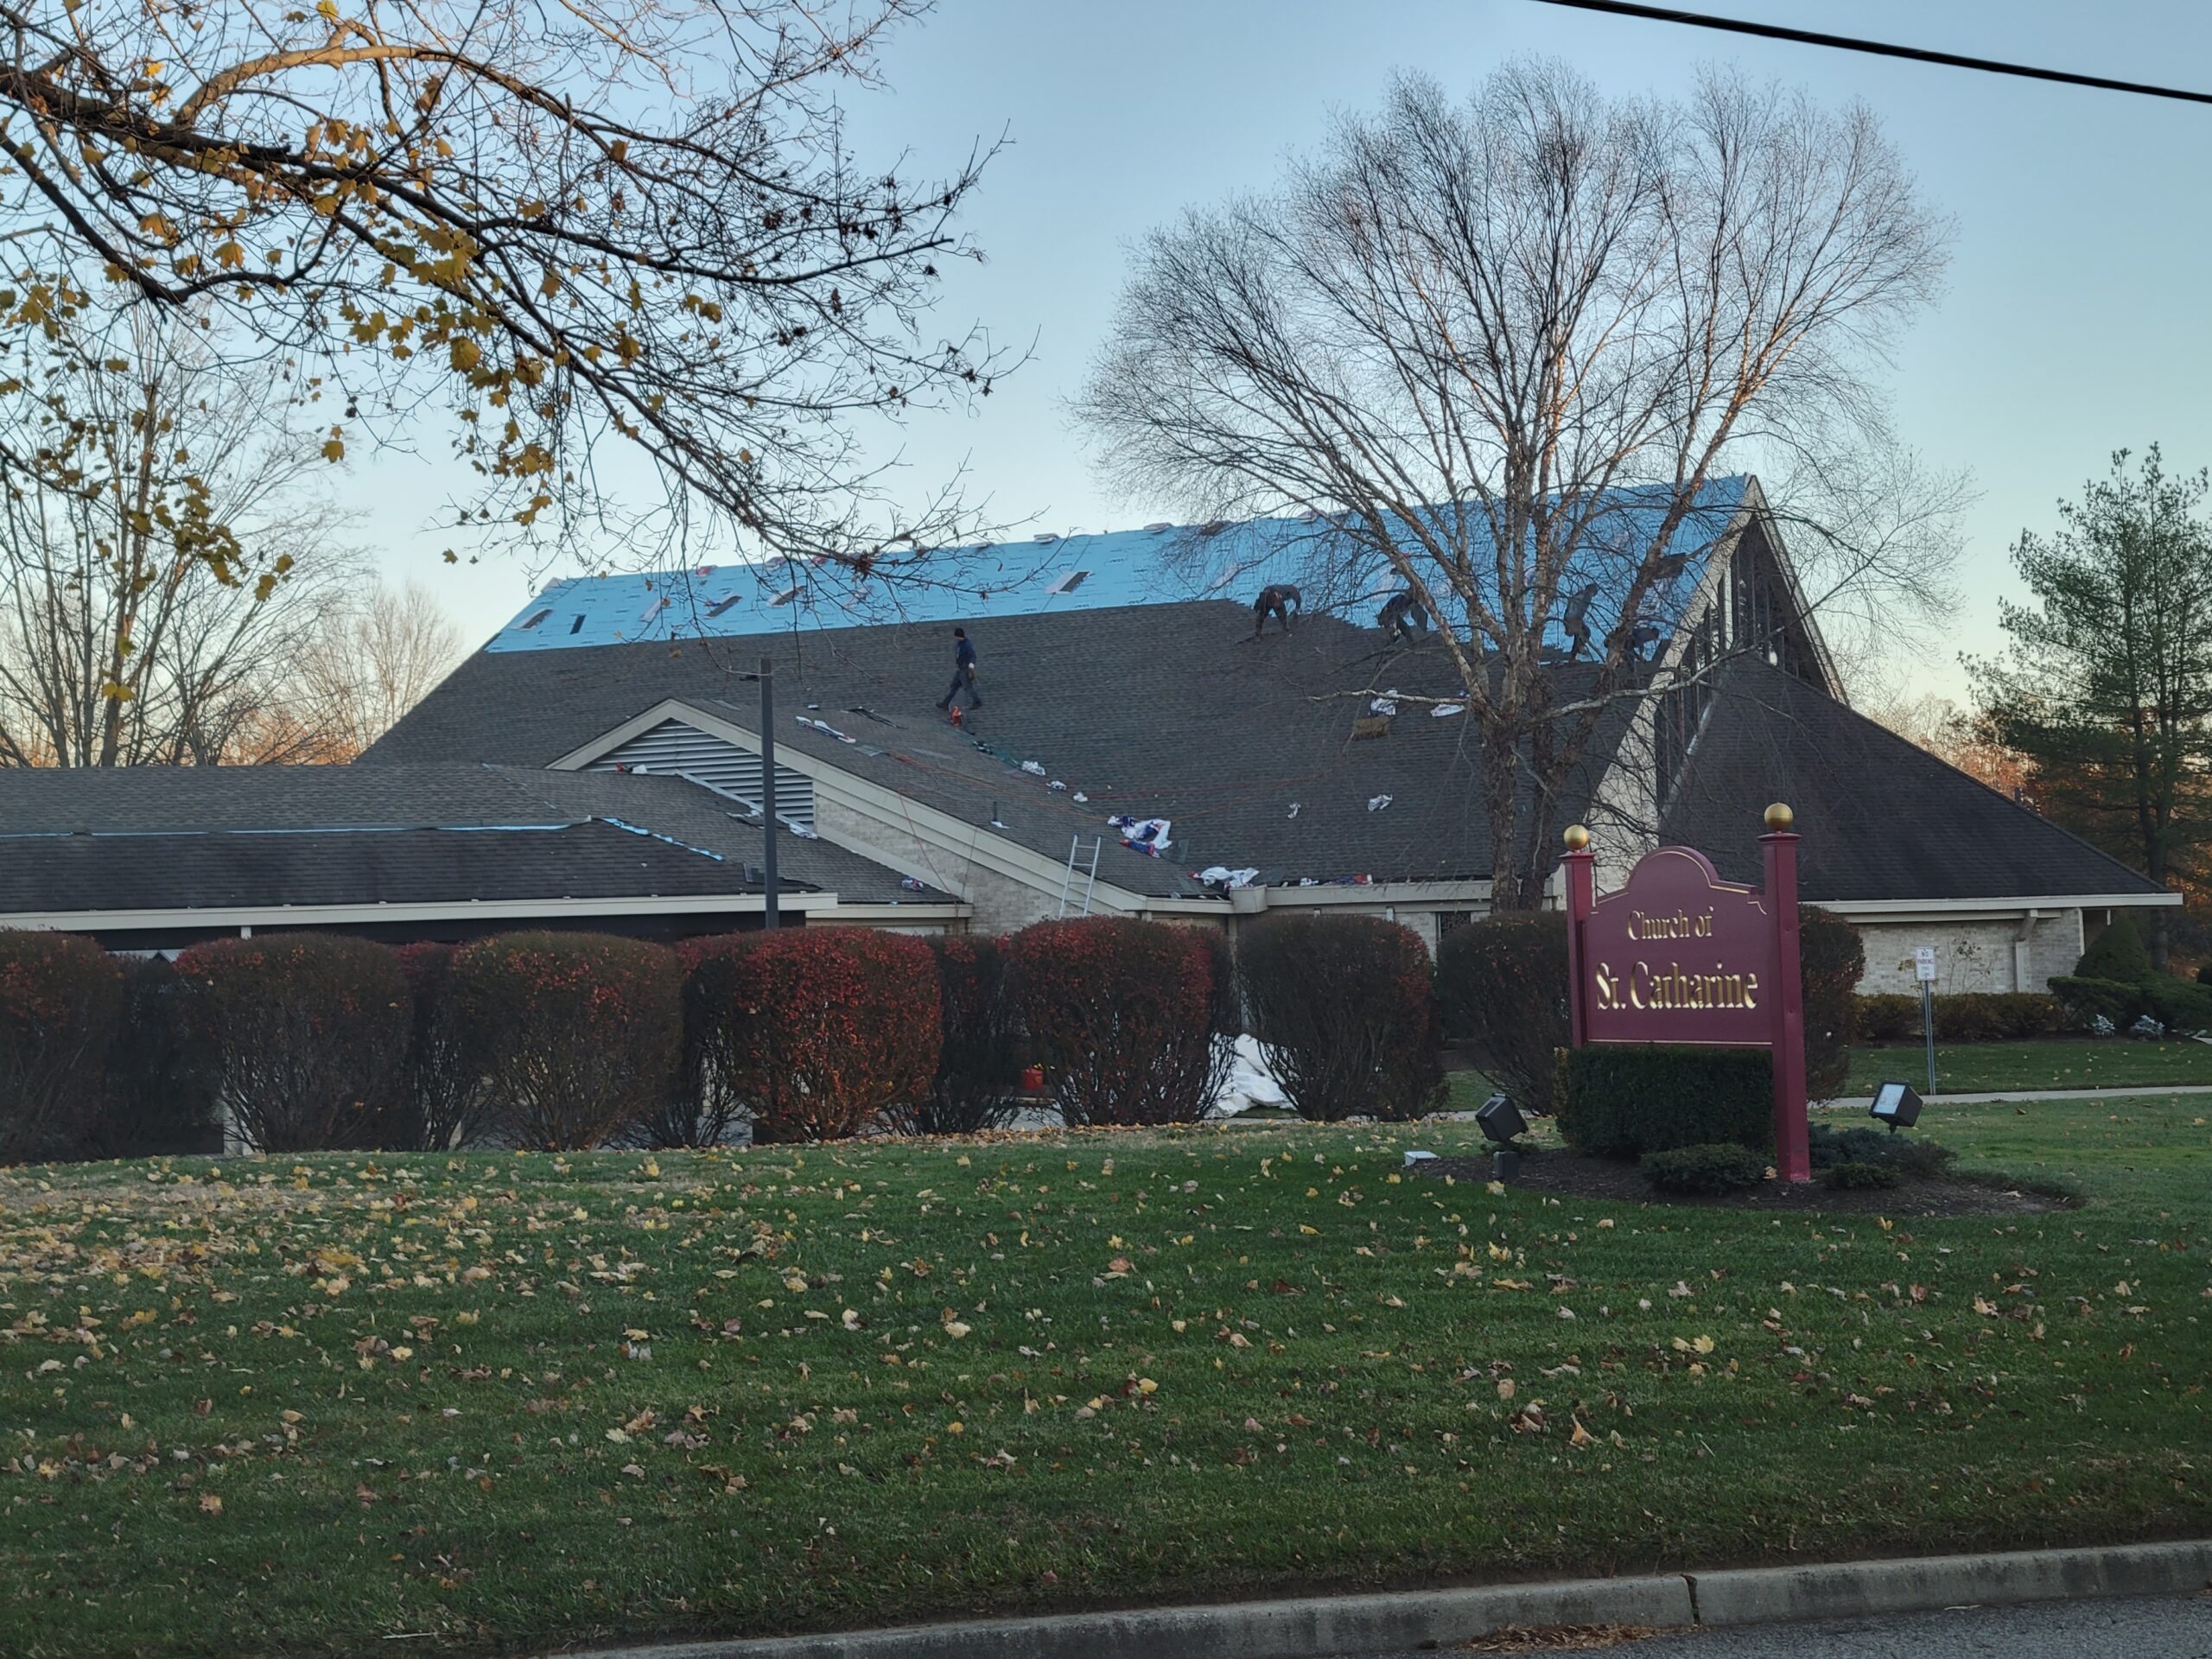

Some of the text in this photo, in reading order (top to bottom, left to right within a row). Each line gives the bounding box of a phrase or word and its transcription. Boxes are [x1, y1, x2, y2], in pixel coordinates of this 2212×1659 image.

[1628, 906, 1714, 941] Church of
[1596, 960, 1759, 1010] St. Catharine
